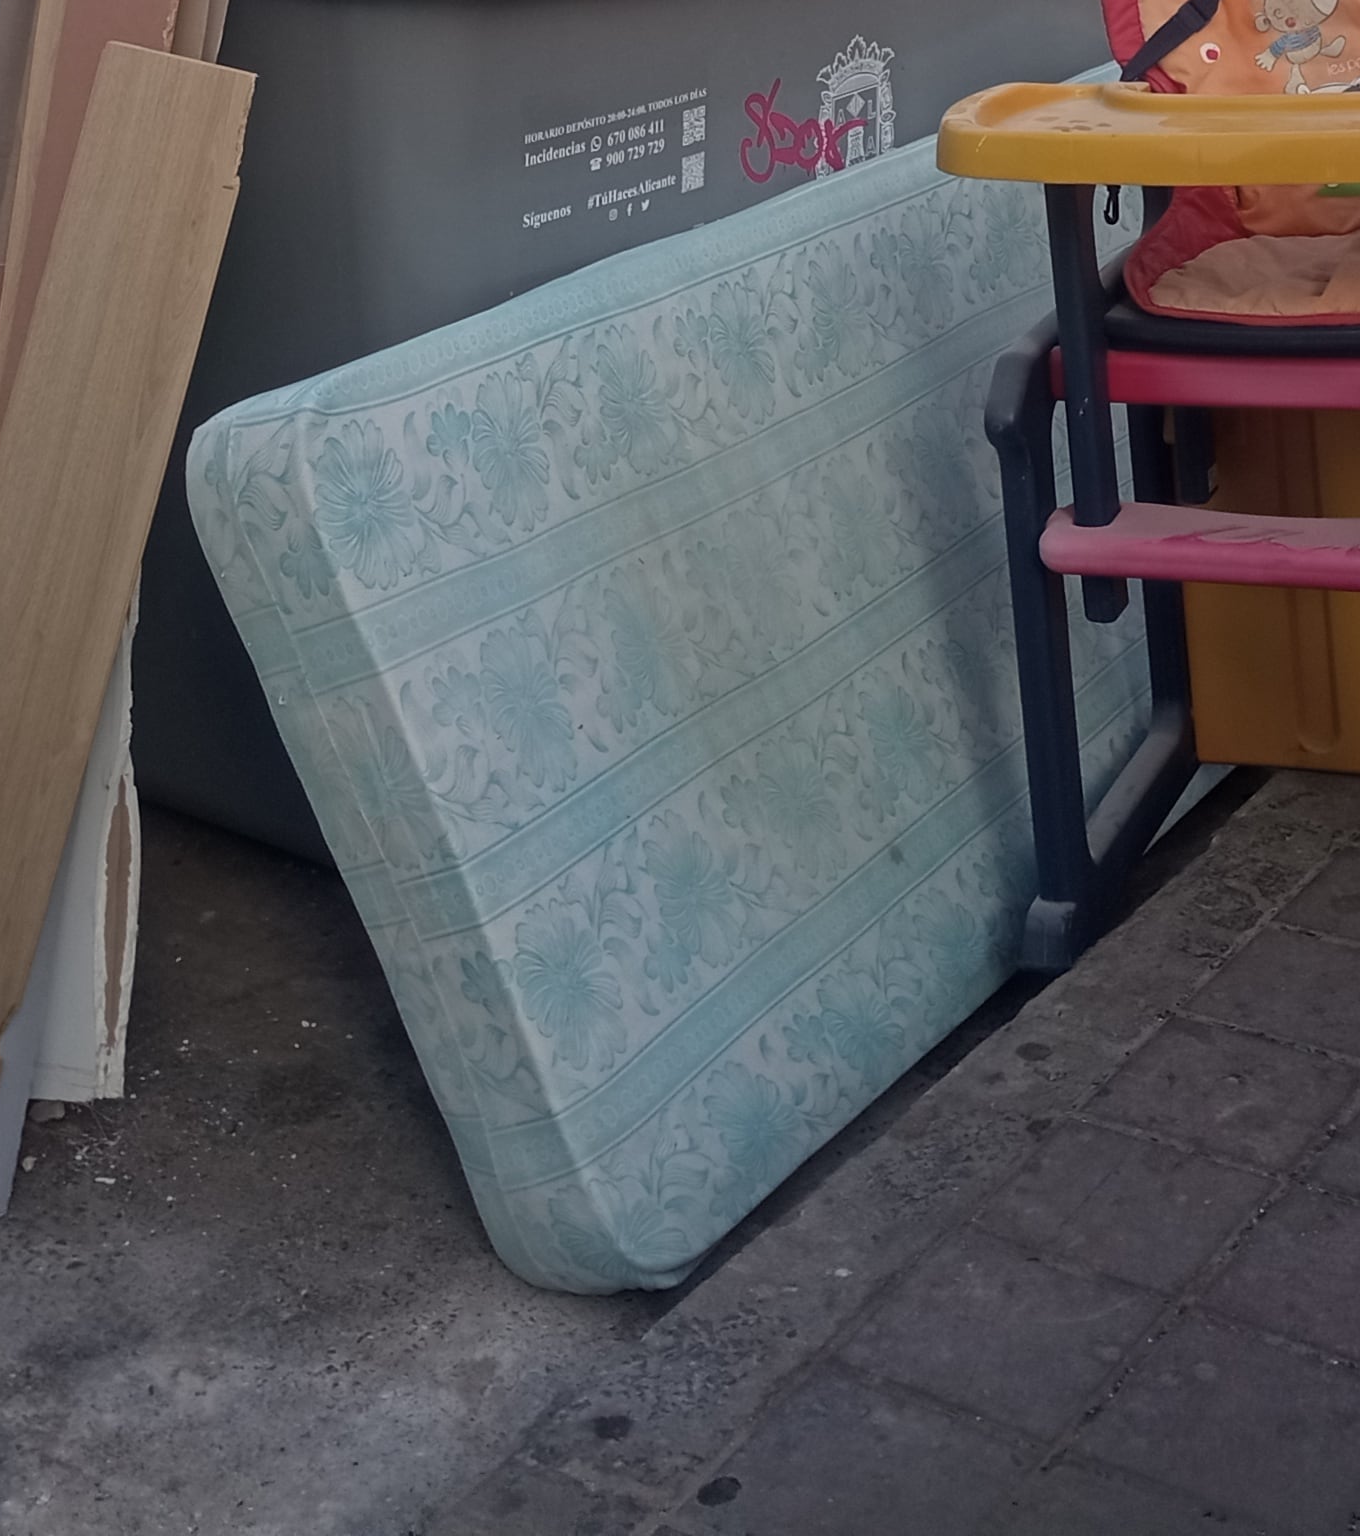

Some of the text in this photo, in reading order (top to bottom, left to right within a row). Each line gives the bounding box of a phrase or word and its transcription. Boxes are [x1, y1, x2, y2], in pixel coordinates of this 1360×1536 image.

[524, 125, 566, 145] HORARIO
[648, 95, 674, 112] TODOS
[674, 92, 690, 106] LOS
[524, 118, 665, 168] Incidencias 670 086 411
[605, 137, 666, 168] 900 729 729
[522, 204, 572, 230] Síguenos
